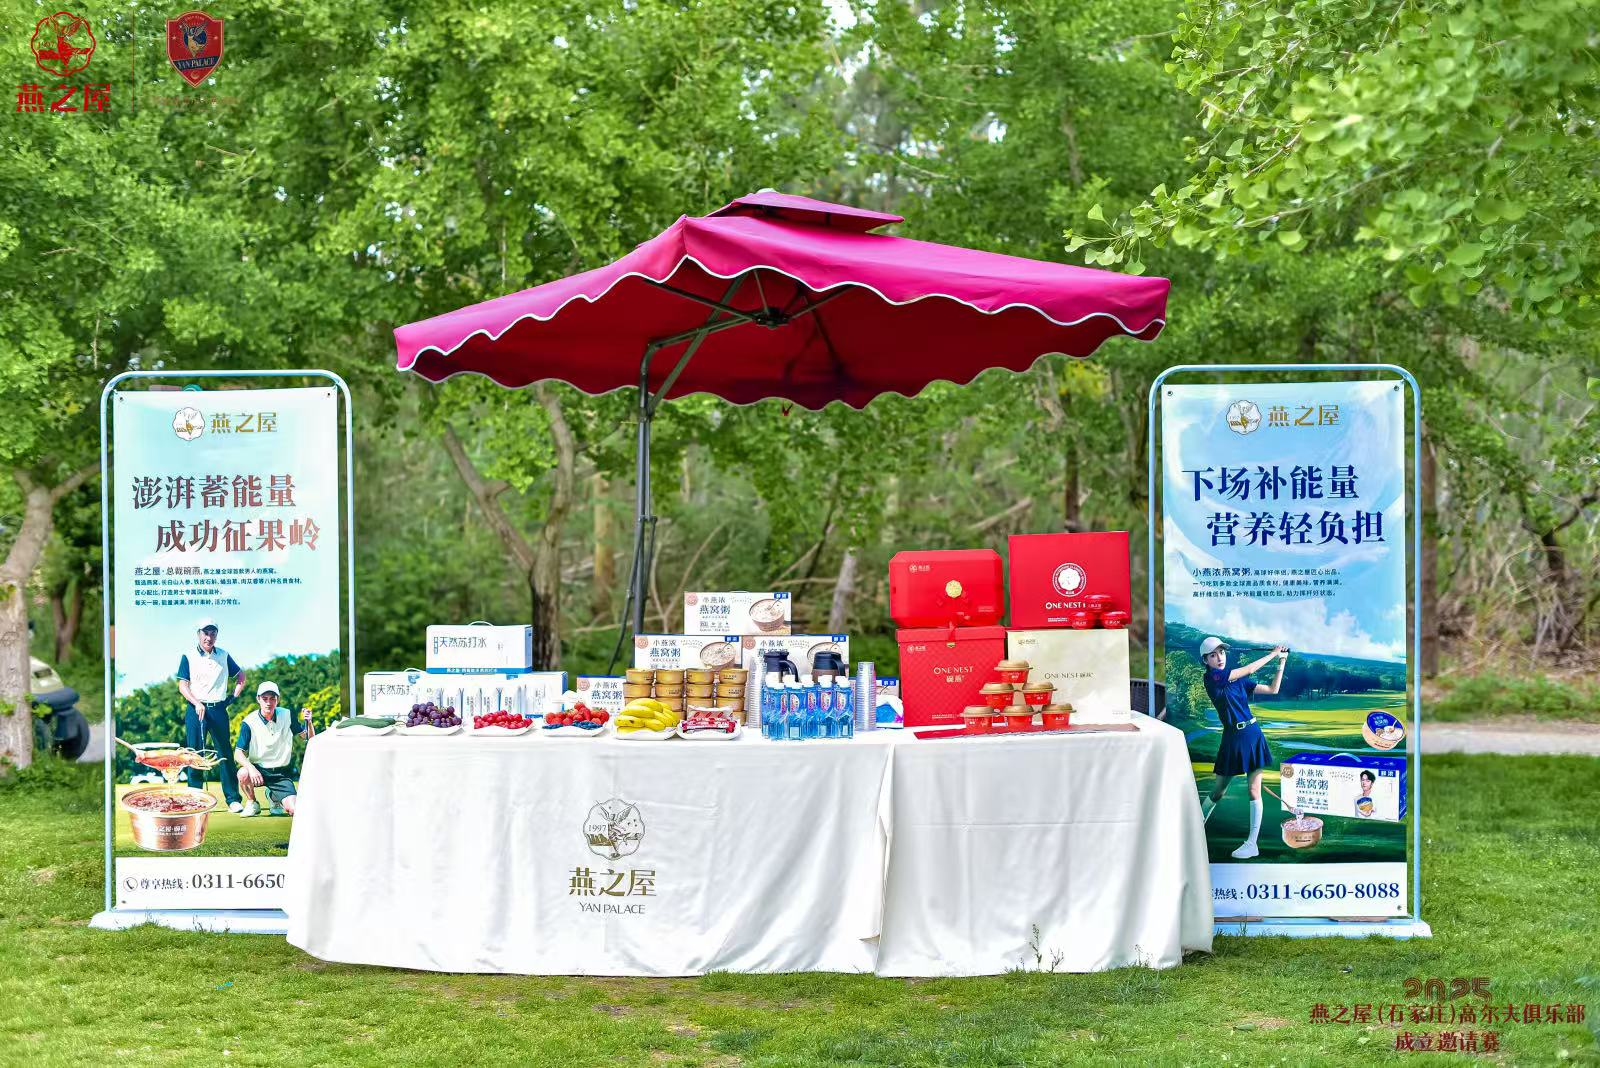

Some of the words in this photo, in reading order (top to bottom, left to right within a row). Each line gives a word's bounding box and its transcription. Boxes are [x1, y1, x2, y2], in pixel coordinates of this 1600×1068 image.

[1267, 404, 1341, 427] 燕之屋
[210, 412, 278, 434] 燕之屋
[1182, 464, 1359, 502] 下场补能量
[131, 474, 297, 510] 澎湃蓄能量
[1206, 510, 1386, 547] 营养轻负担
[155, 517, 321, 553] 成功征果岭
[699, 604, 731, 615] 燕窝粥
[1045, 602, 1062, 610] ONE
[1063, 601, 1082, 609] NEST
[439, 636, 487, 649] 天然苏打水
[653, 639, 677, 647] 小燕浓
[760, 639, 784, 648] 小燕浓
[649, 647, 681, 658] 燕窝粥
[933, 667, 951, 675] ONE
[953, 665, 973, 674] NEST
[1044, 672, 1059, 680] ONE
[591, 690, 623, 700] 燕窝粥
[1298, 768, 1323, 778] 小燕浓
[1296, 777, 1328, 791] 燕窝粥
[588, 823, 607, 832] 1997
[568, 866, 657, 897] 燕之屋
[579, 901, 601, 913] YAN
[603, 903, 645, 915] PALACE
